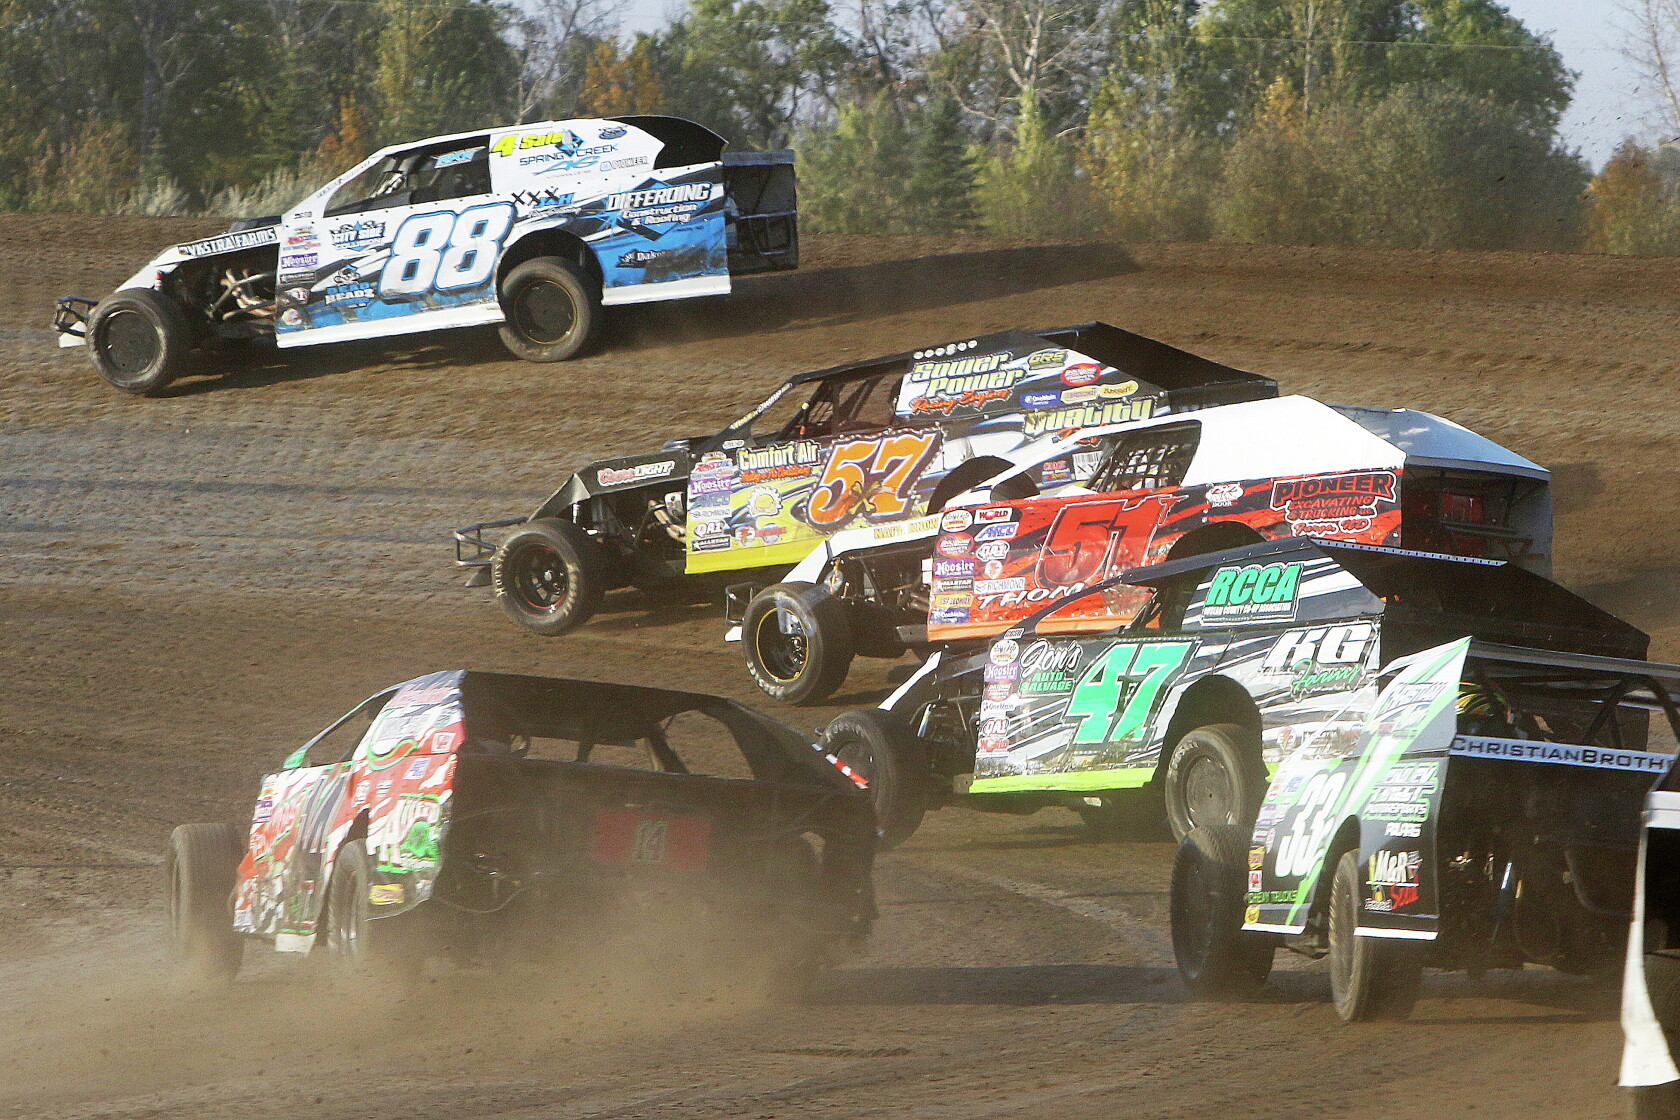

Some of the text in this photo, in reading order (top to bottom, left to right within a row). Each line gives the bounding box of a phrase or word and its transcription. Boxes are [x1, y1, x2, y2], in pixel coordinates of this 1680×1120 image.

[491, 134, 519, 158] 4
[519, 132, 563, 150] Sale
[519, 143, 618, 167] SPRING CREEK
[606, 183, 711, 212] DIFFERDING
[622, 203, 698, 220] Construction
[644, 213, 692, 226] Roofing
[234, 229, 277, 249] FARMS
[378, 200, 513, 302] 88
[926, 369, 1027, 398] Power
[1024, 398, 1154, 438] Quality
[739, 441, 820, 472] Comfort Air
[634, 462, 674, 478] LIGHT
[1274, 474, 1391, 507] PIONEER
[1288, 496, 1374, 511] EXCAVATING
[1299, 506, 1356, 519] TRUCKING
[979, 510, 1009, 520] WORLD
[874, 528, 904, 539] NAPA
[909, 519, 939, 534] KNOW
[935, 560, 975, 574] Hoosier
[987, 580, 1025, 591] RICHMOND
[1205, 564, 1301, 606] RCCA
[1258, 602, 1292, 612] ASSOCIATION
[1020, 639, 1083, 680] Jon's
[985, 666, 1018, 680] Hoosier
[1030, 672, 1064, 683] AUTO
[1020, 681, 1072, 692] SALVAGE
[1065, 643, 1194, 745] 47
[986, 720, 1007, 735] QA1
[1451, 738, 1674, 771] CHRISTIANBROTH
